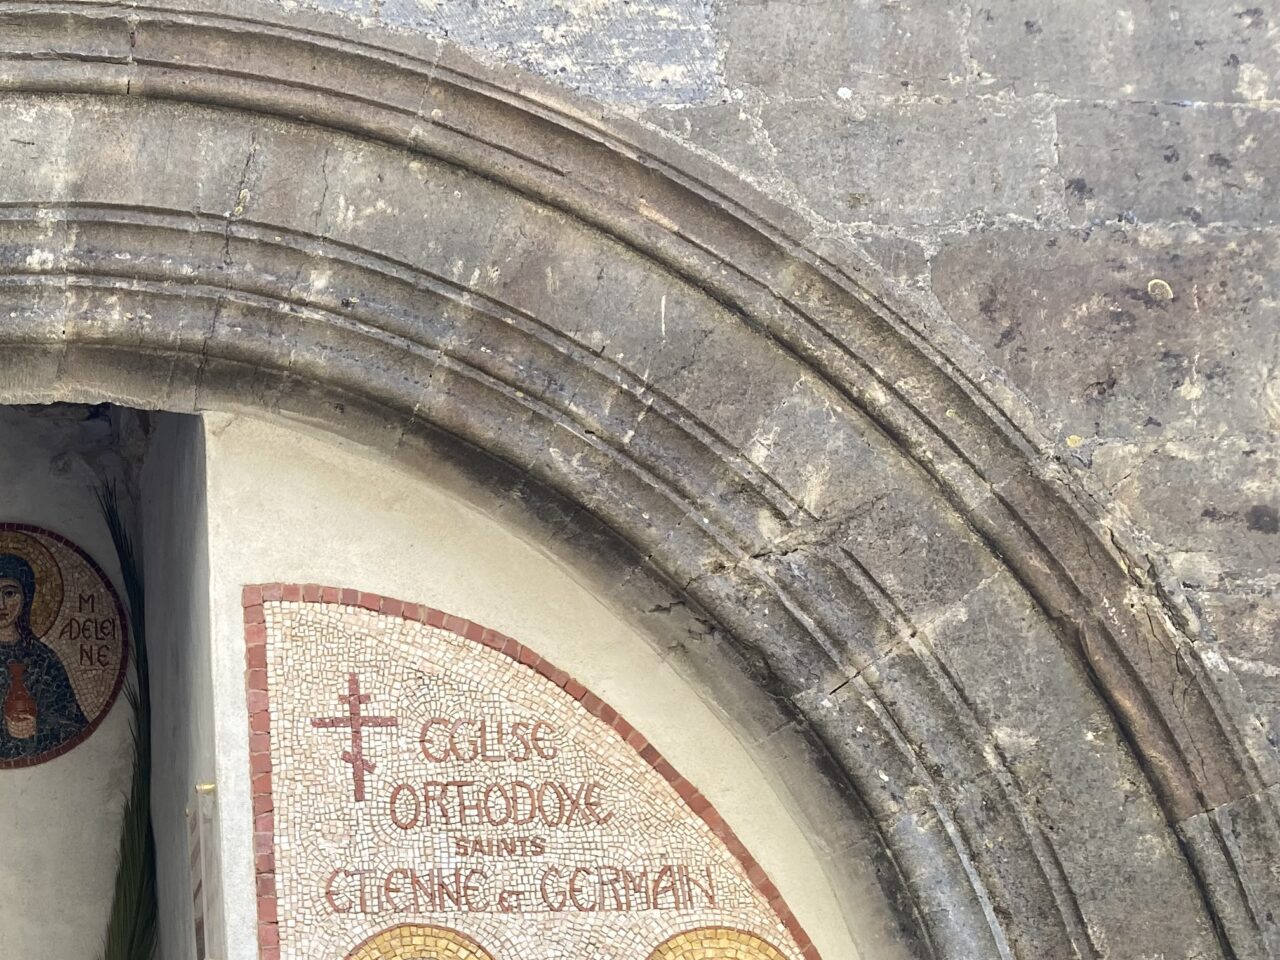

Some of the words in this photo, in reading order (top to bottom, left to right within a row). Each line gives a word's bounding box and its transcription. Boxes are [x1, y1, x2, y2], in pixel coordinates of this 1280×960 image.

[79, 593, 95, 613] M
[59, 618, 116, 640] ADELEI
[80, 644, 110, 667] NE
[420, 717, 558, 762] EGLISE
[390, 780, 613, 830] ORTHODOXE
[455, 836, 546, 857] SAINTS
[325, 867, 490, 913] ETIENNE
[541, 866, 718, 912] GERMAIN
